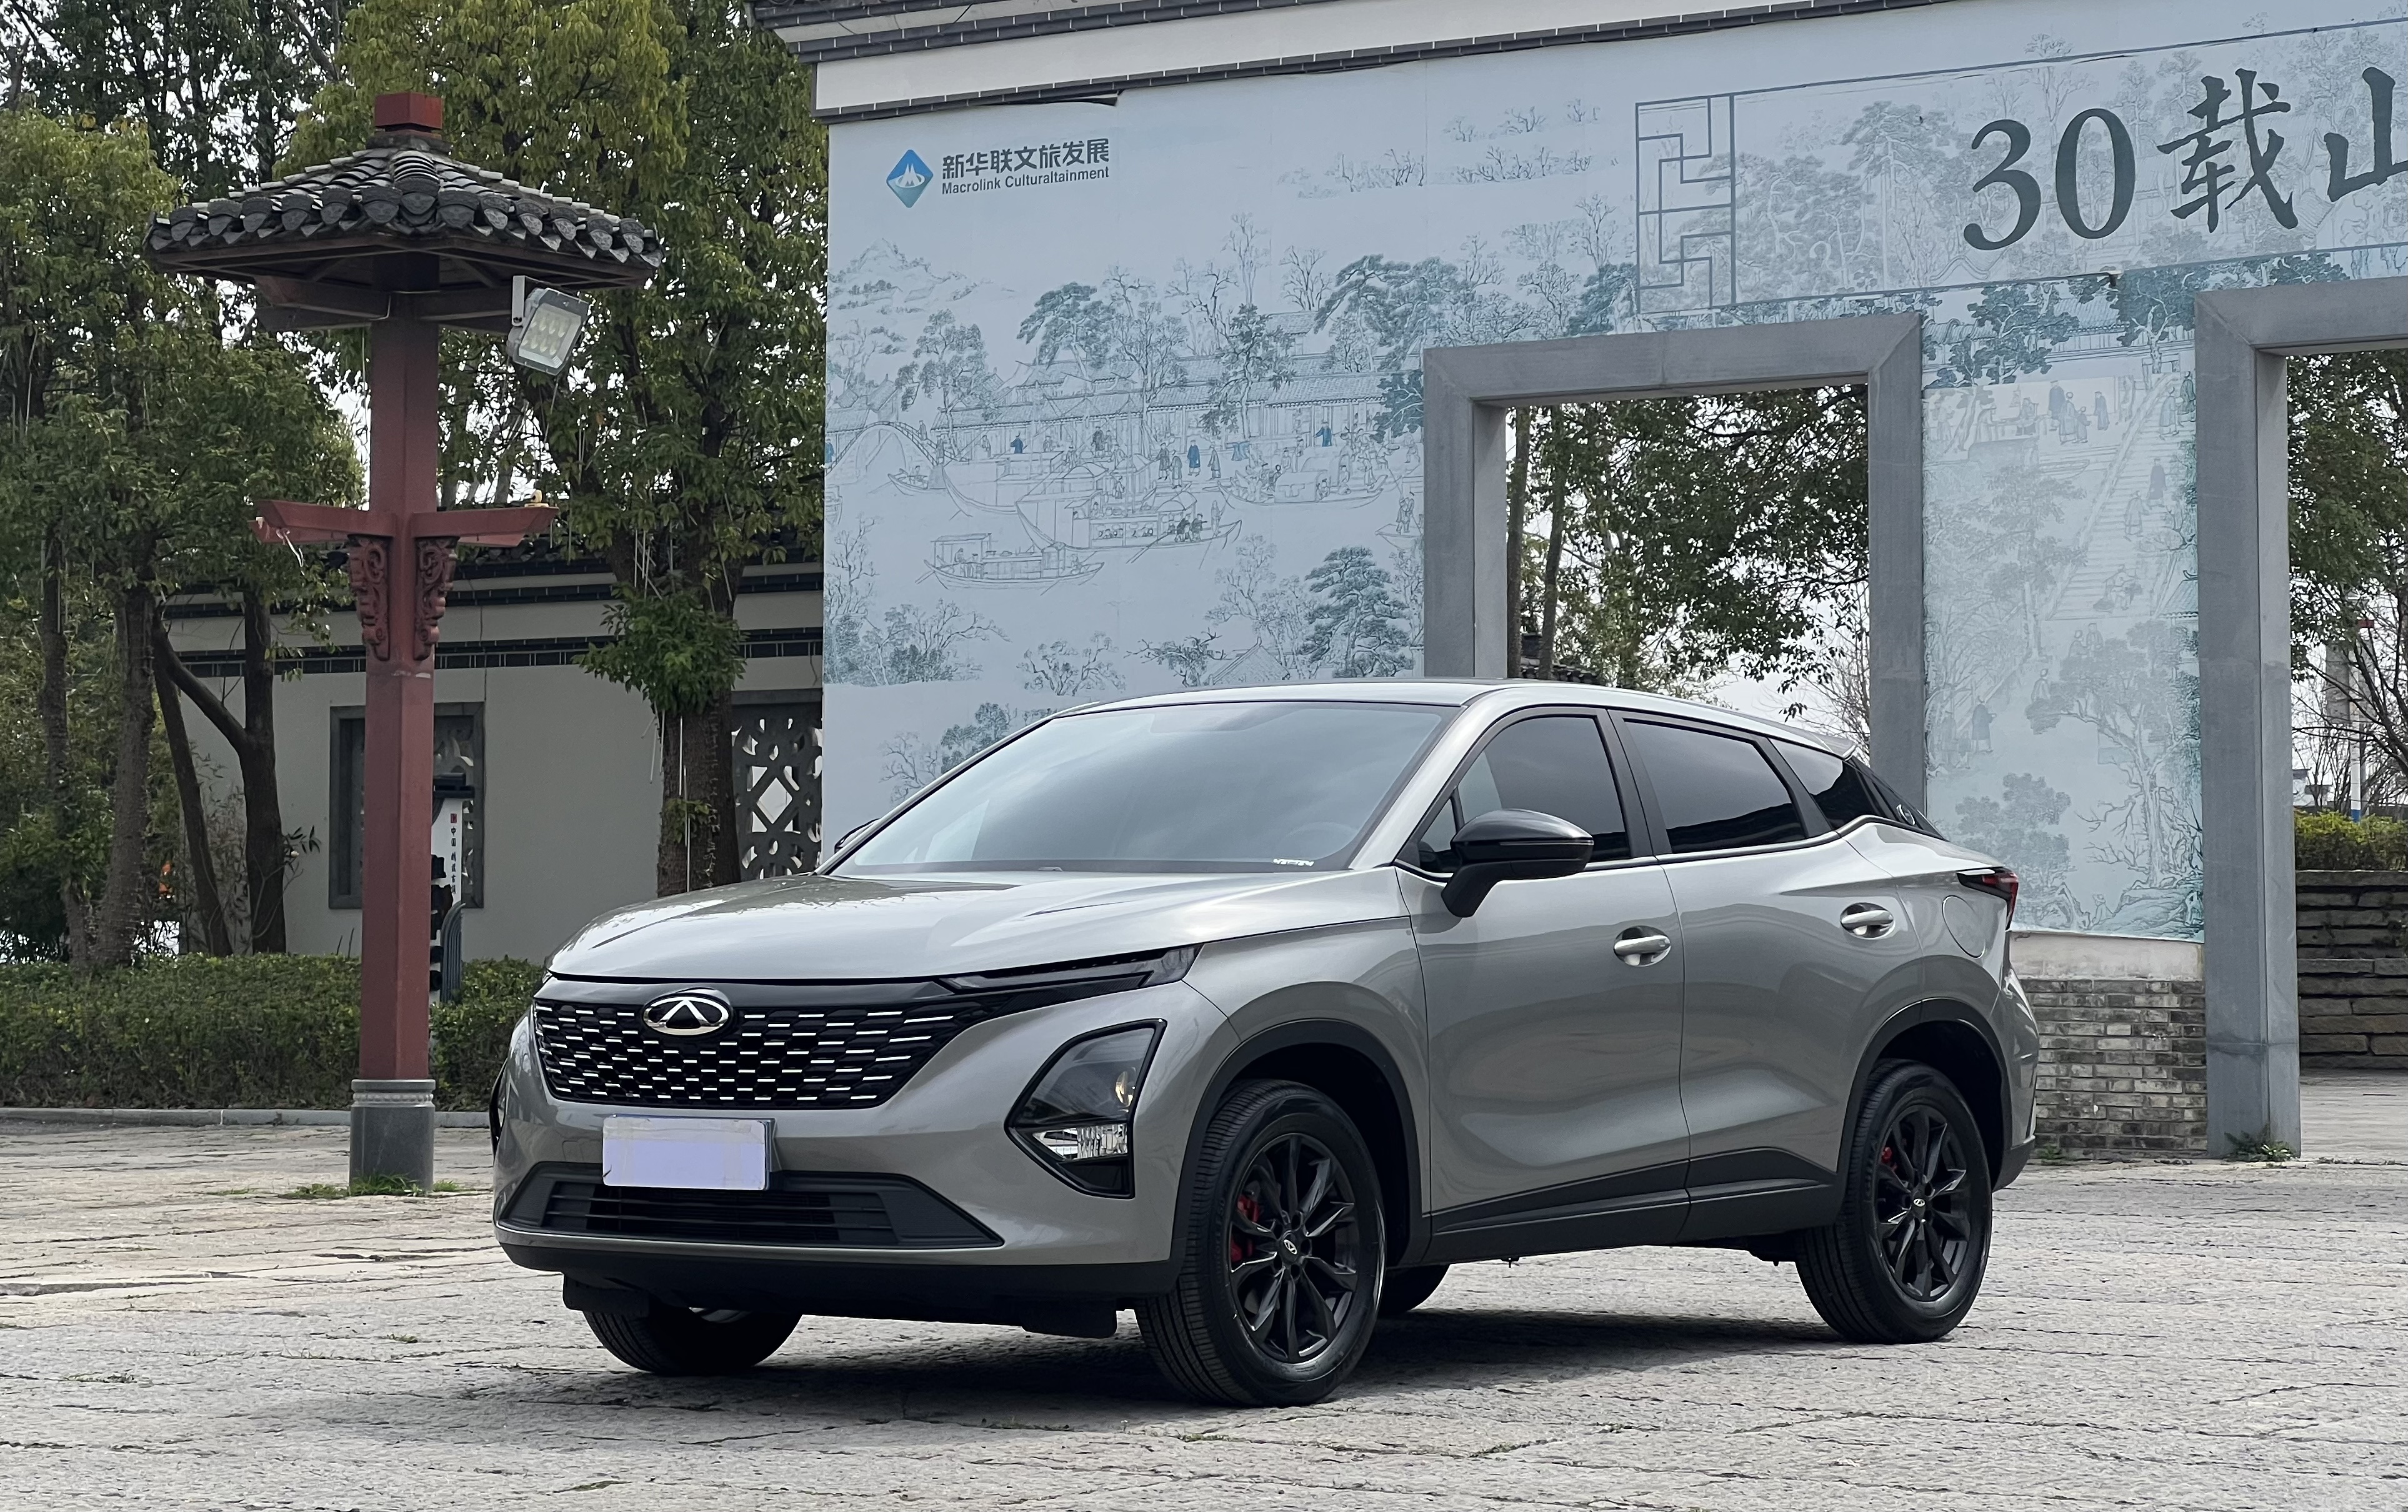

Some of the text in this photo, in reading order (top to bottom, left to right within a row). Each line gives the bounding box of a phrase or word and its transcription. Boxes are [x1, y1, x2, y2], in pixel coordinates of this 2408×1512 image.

[942, 138, 1109, 179] 新华联文旅发展
[942, 167, 1109, 194] Macrolink Culturaltainment
